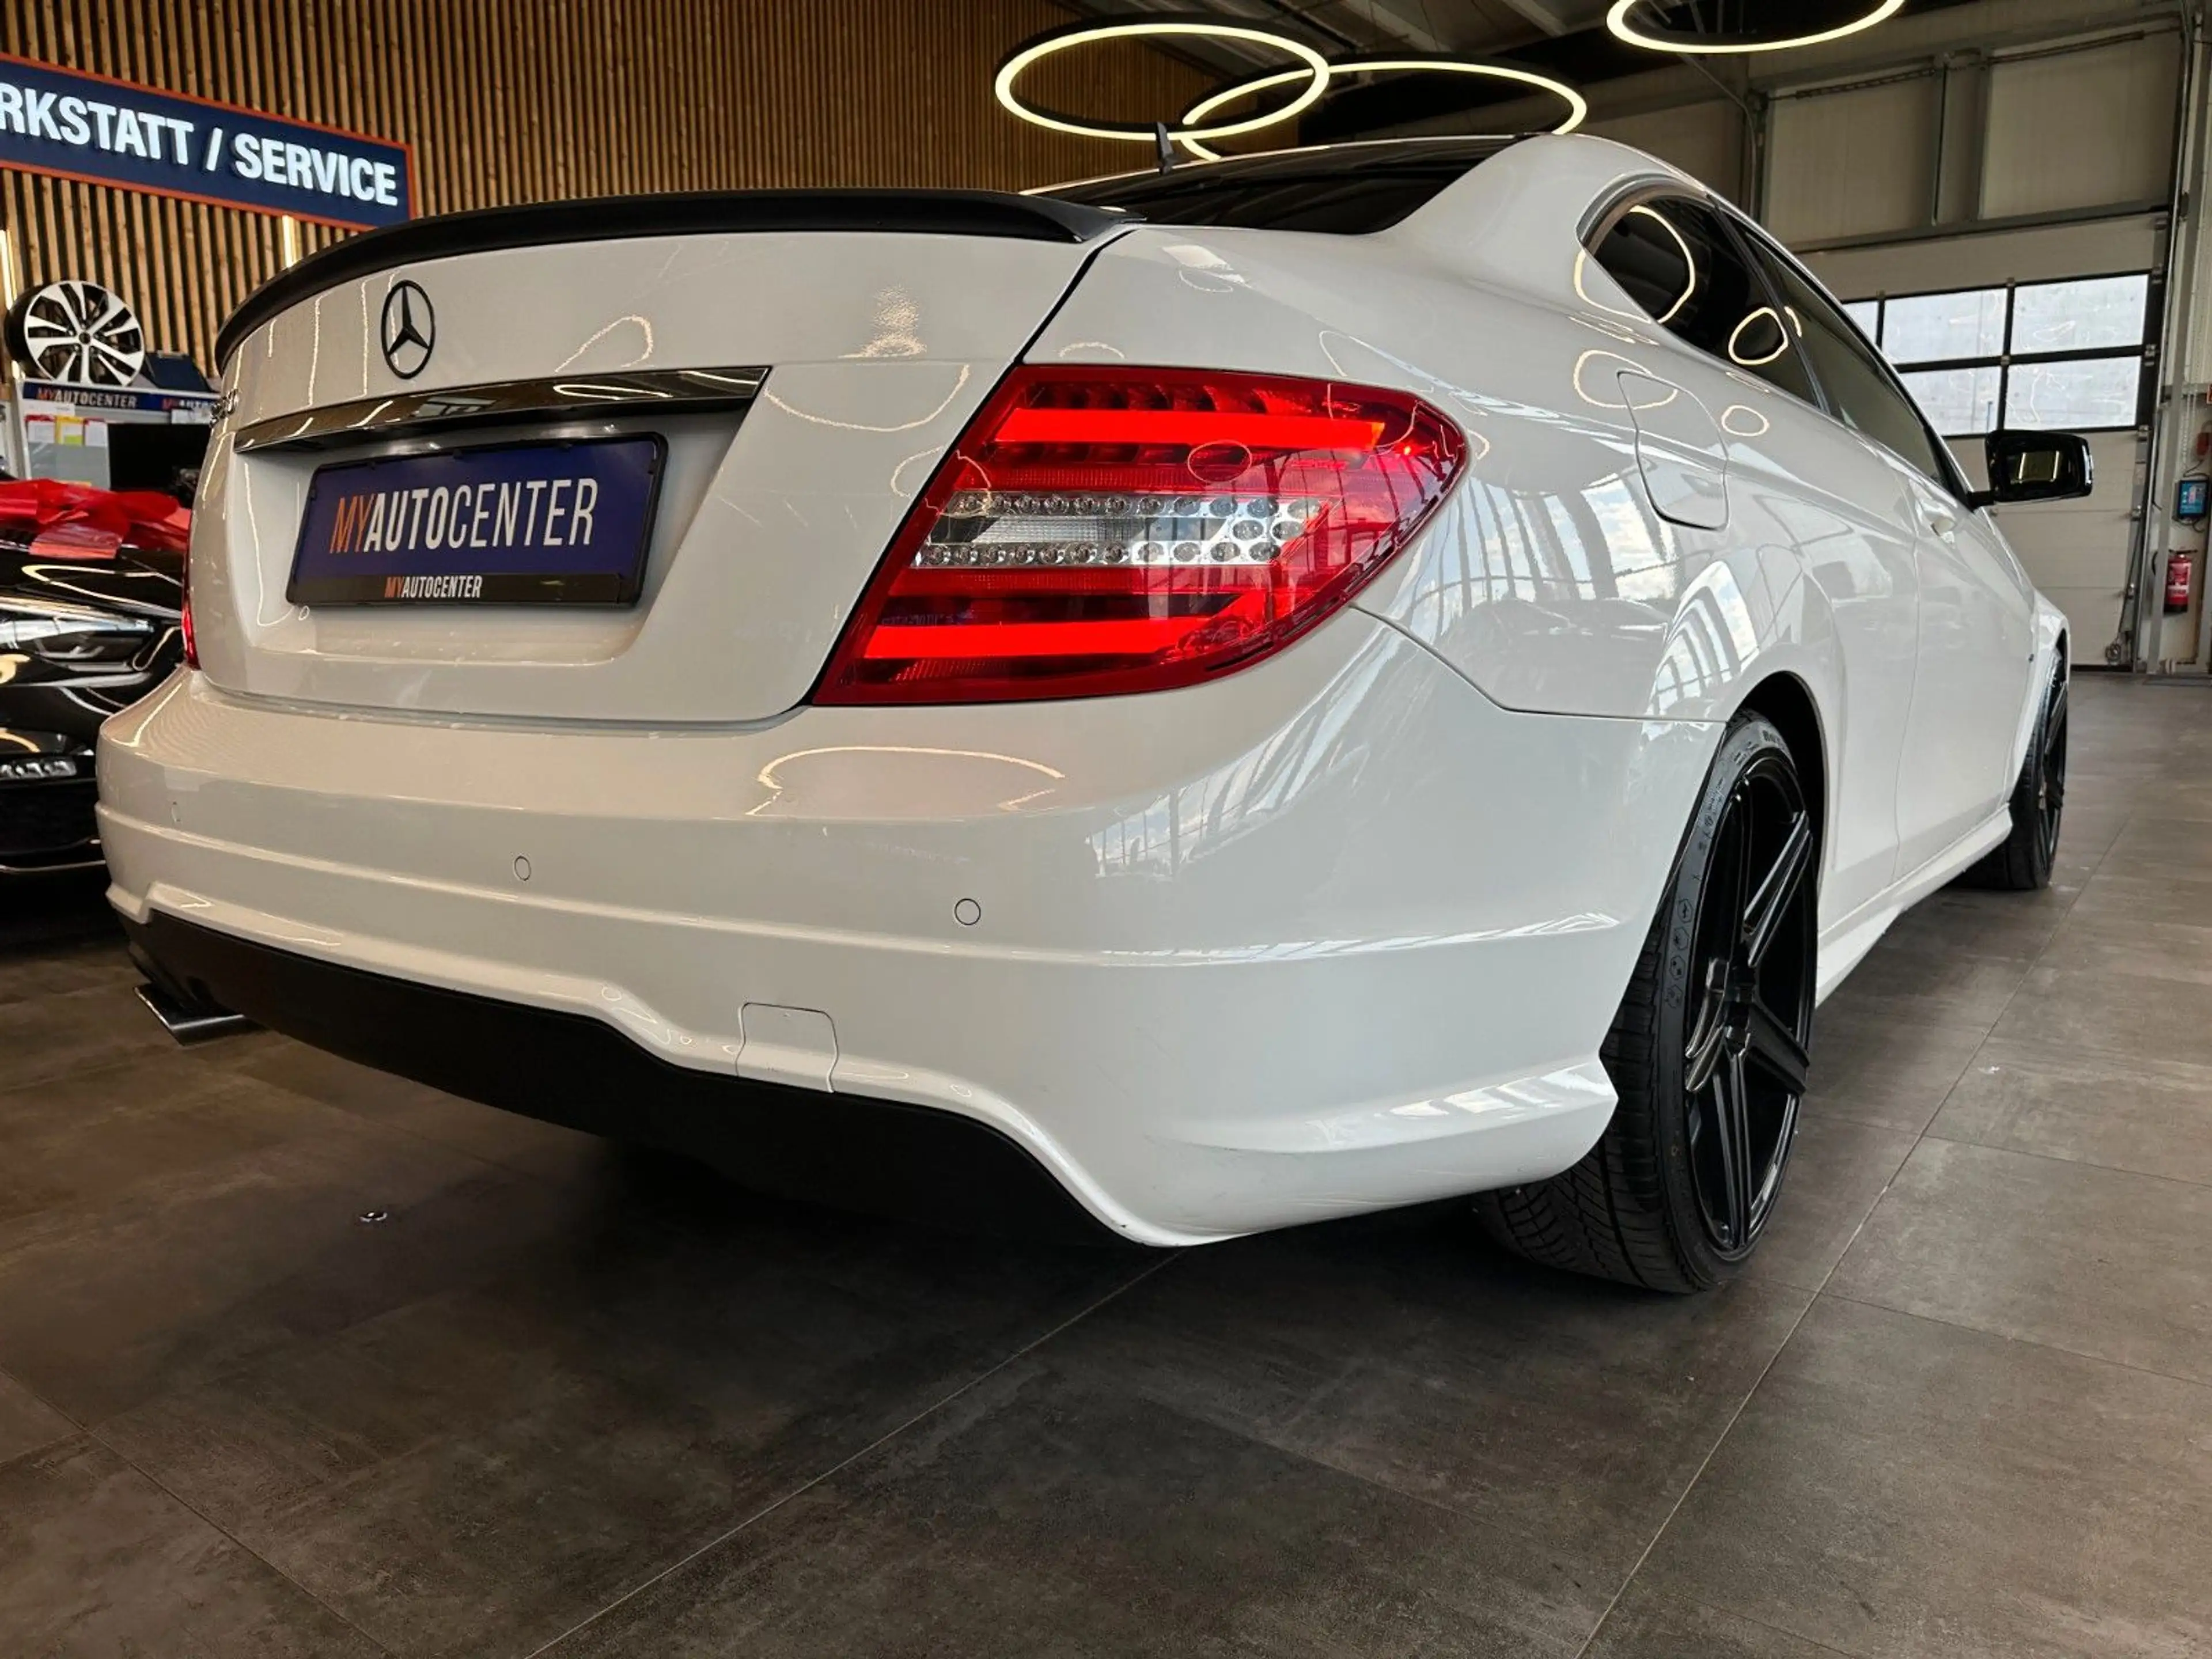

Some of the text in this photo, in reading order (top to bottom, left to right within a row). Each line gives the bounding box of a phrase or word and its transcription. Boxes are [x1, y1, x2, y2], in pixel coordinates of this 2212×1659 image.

[205, 128, 223, 172] /
[234, 133, 399, 207] SERVICE
[36, 387, 138, 408] MYAUTOCENTER
[329, 478, 599, 554] MYAUTOCENTER
[384, 575, 483, 598] MYAUTOCENTER
